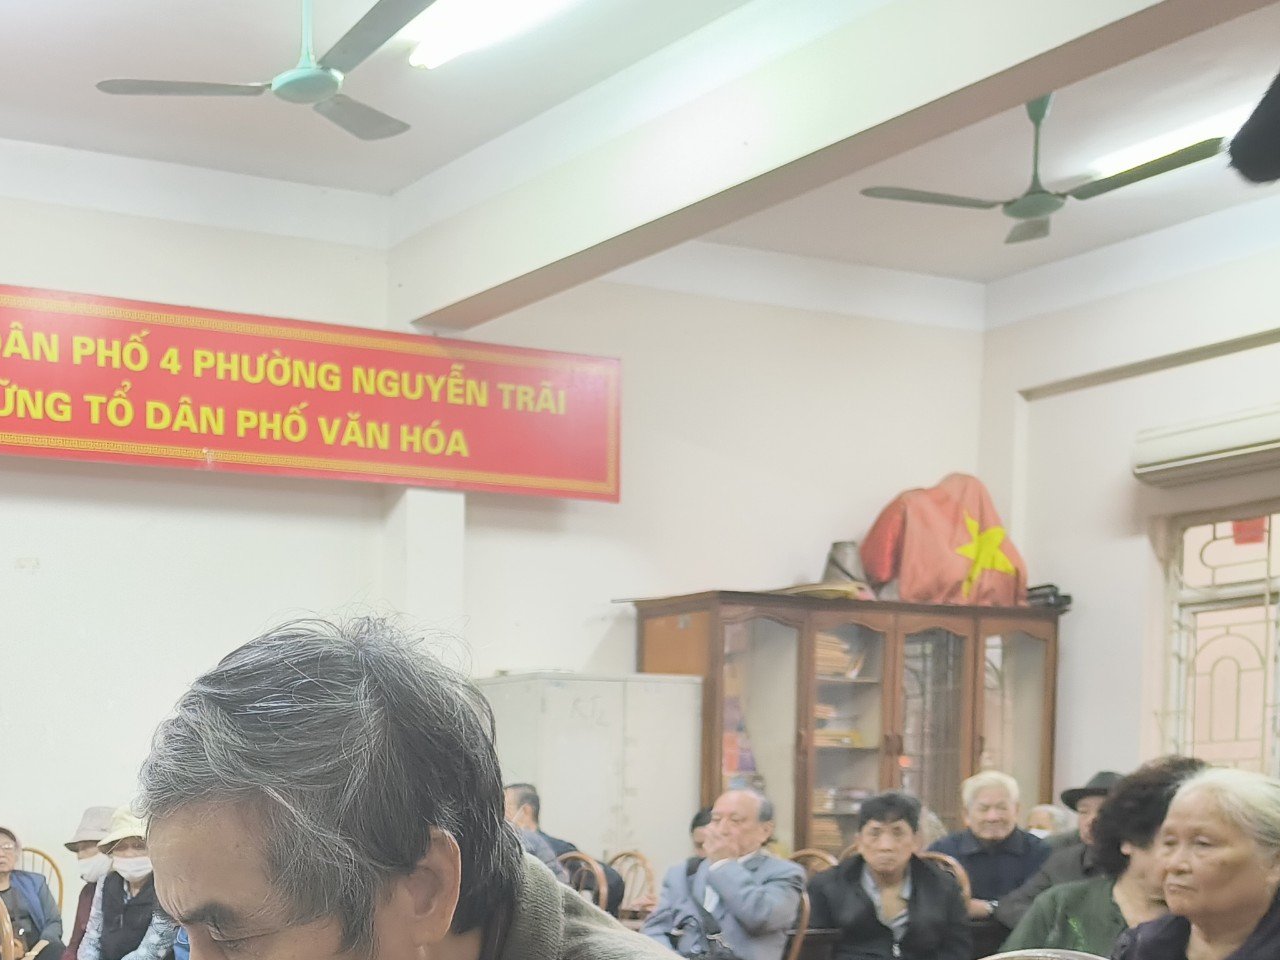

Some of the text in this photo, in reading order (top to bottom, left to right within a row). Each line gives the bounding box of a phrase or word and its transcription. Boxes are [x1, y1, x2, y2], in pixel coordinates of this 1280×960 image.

[72, 329, 150, 373] PHỐ
[159, 346, 182, 376] 4
[193, 348, 342, 393] PHƯỜNG
[352, 363, 489, 407] NGUYỄN
[498, 380, 566, 415] TRÃI
[84, 380, 135, 428] TỔ
[145, 395, 226, 437] DÂN
[236, 402, 309, 443] PHỐ
[318, 411, 391, 450] VĂN
[399, 420, 470, 457] HÓA
